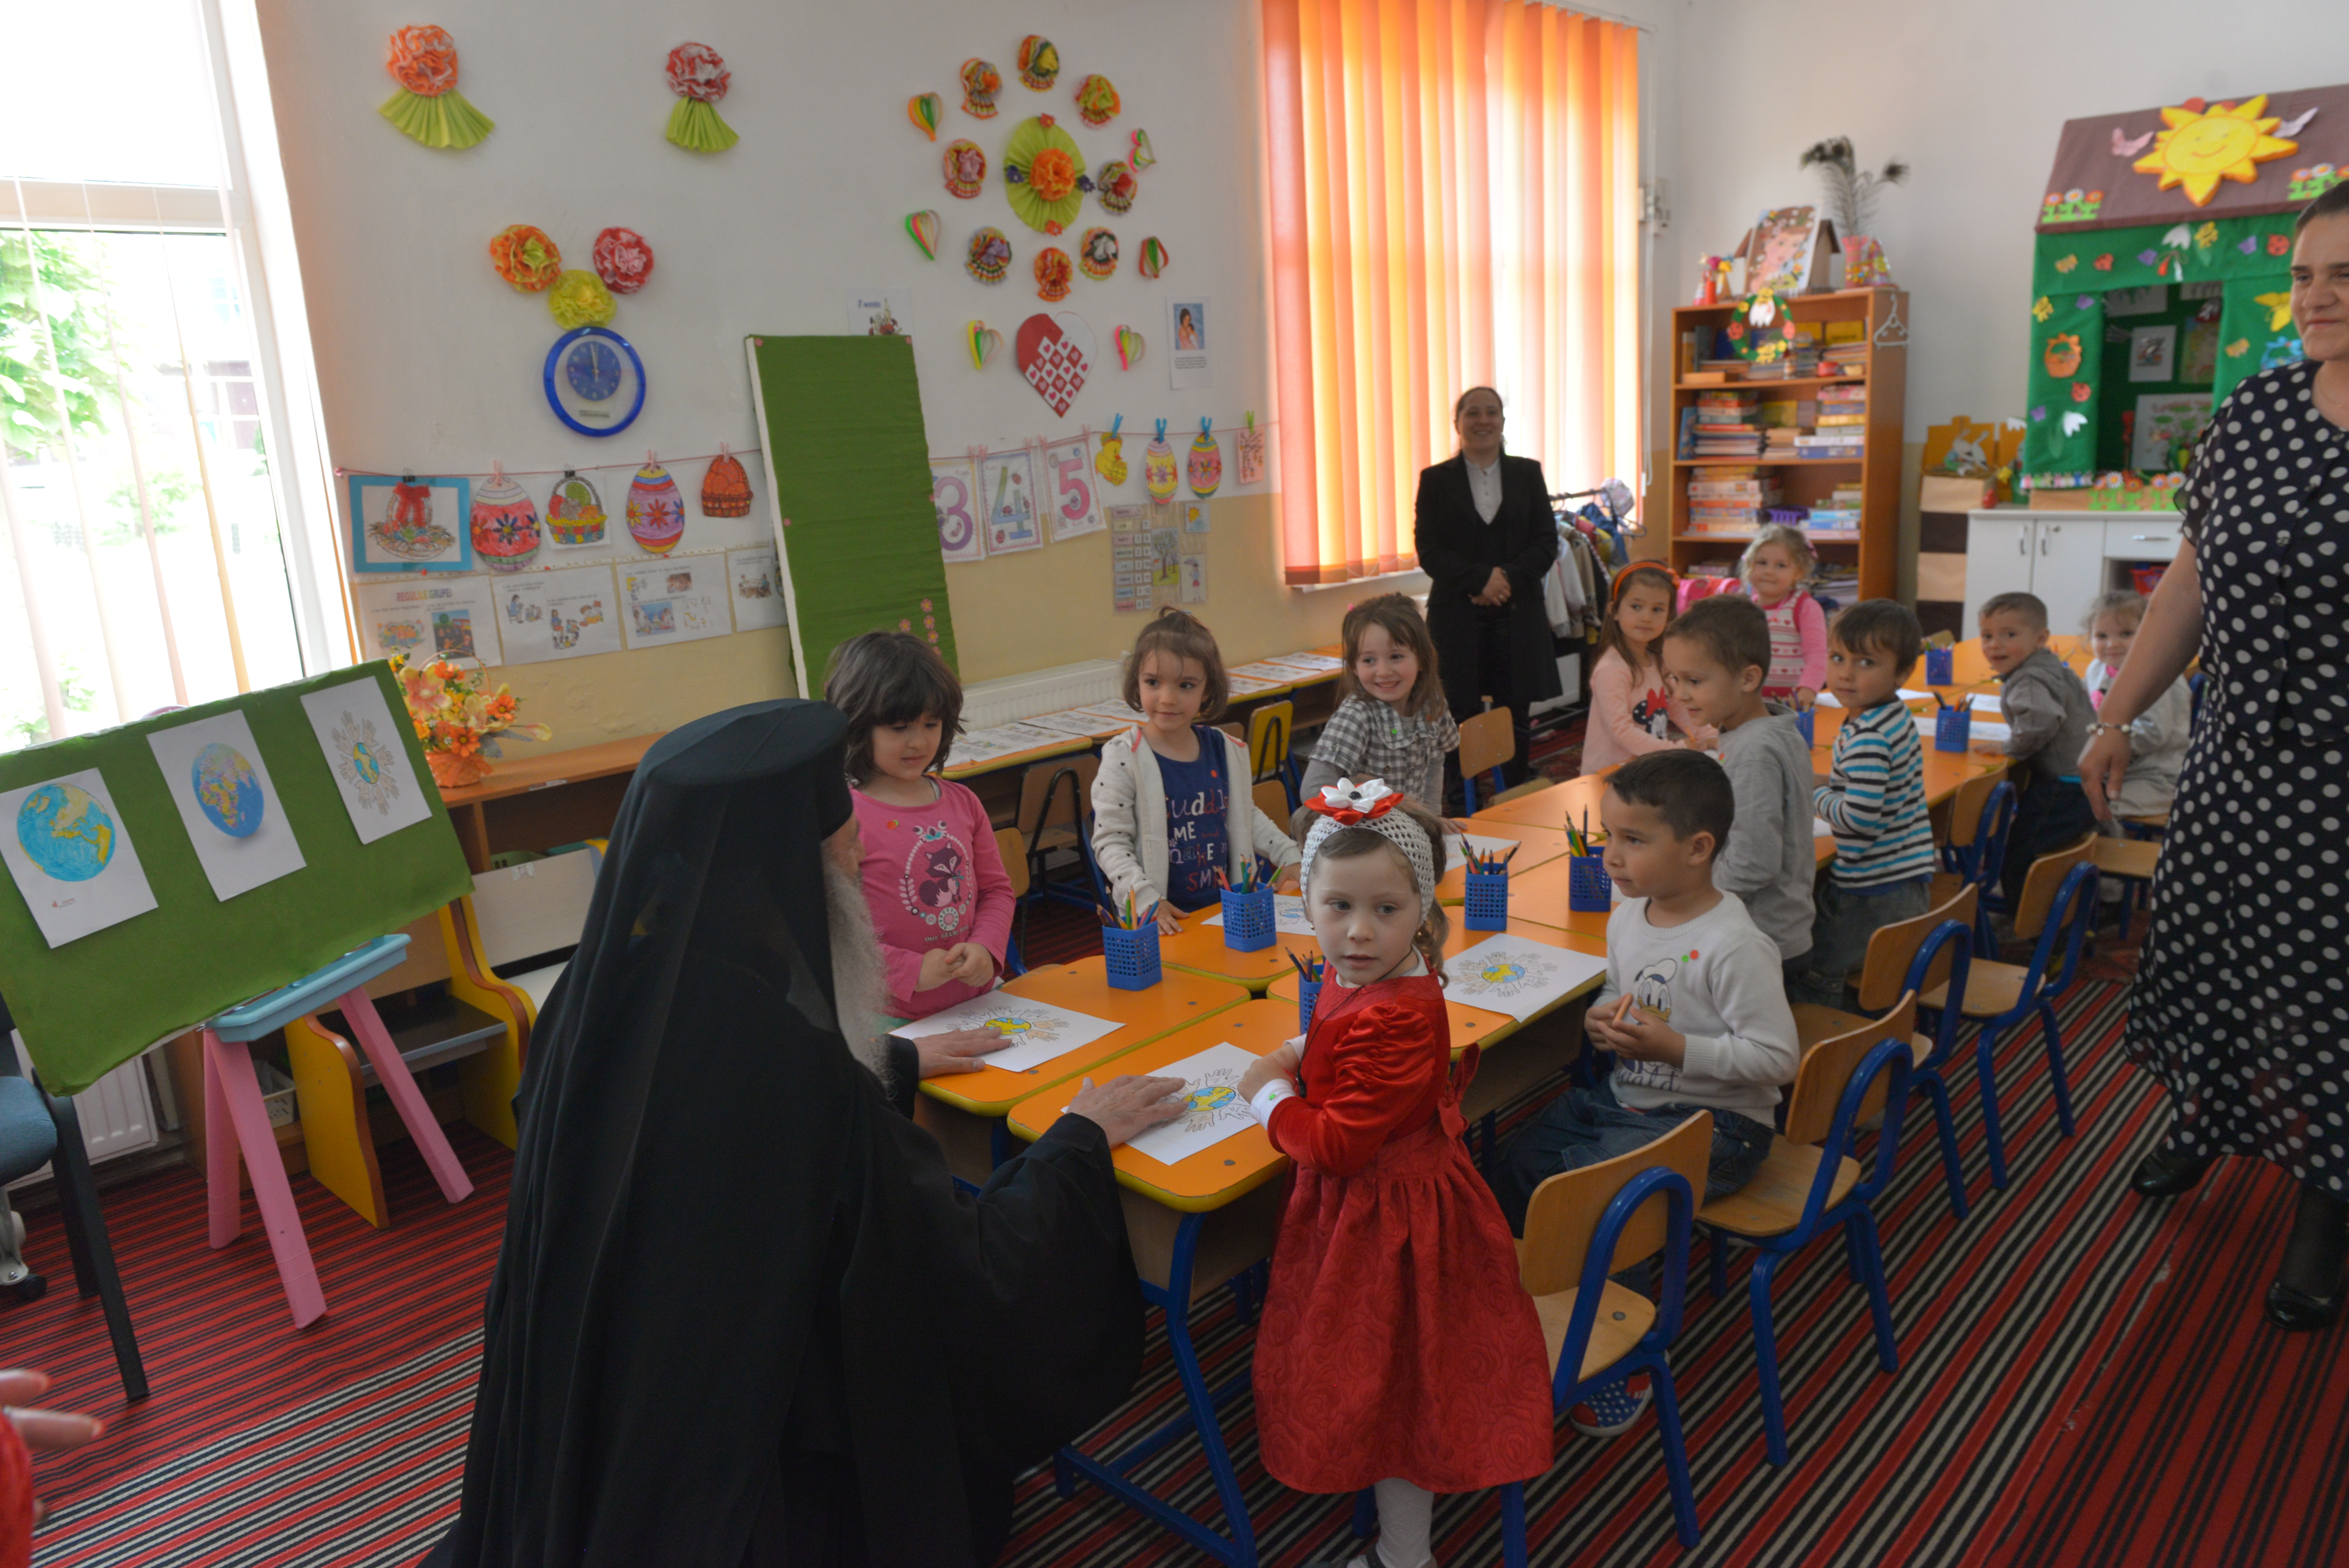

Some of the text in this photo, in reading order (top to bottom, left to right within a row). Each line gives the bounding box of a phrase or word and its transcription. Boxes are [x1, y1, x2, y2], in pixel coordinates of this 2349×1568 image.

[991, 466, 1033, 540] 4
[1059, 458, 1090, 520] 5
[934, 476, 973, 551] 3
[1166, 788, 1229, 819] uddl
[1174, 821, 1196, 841] ME
[1616, 1067, 1680, 1092] nald
